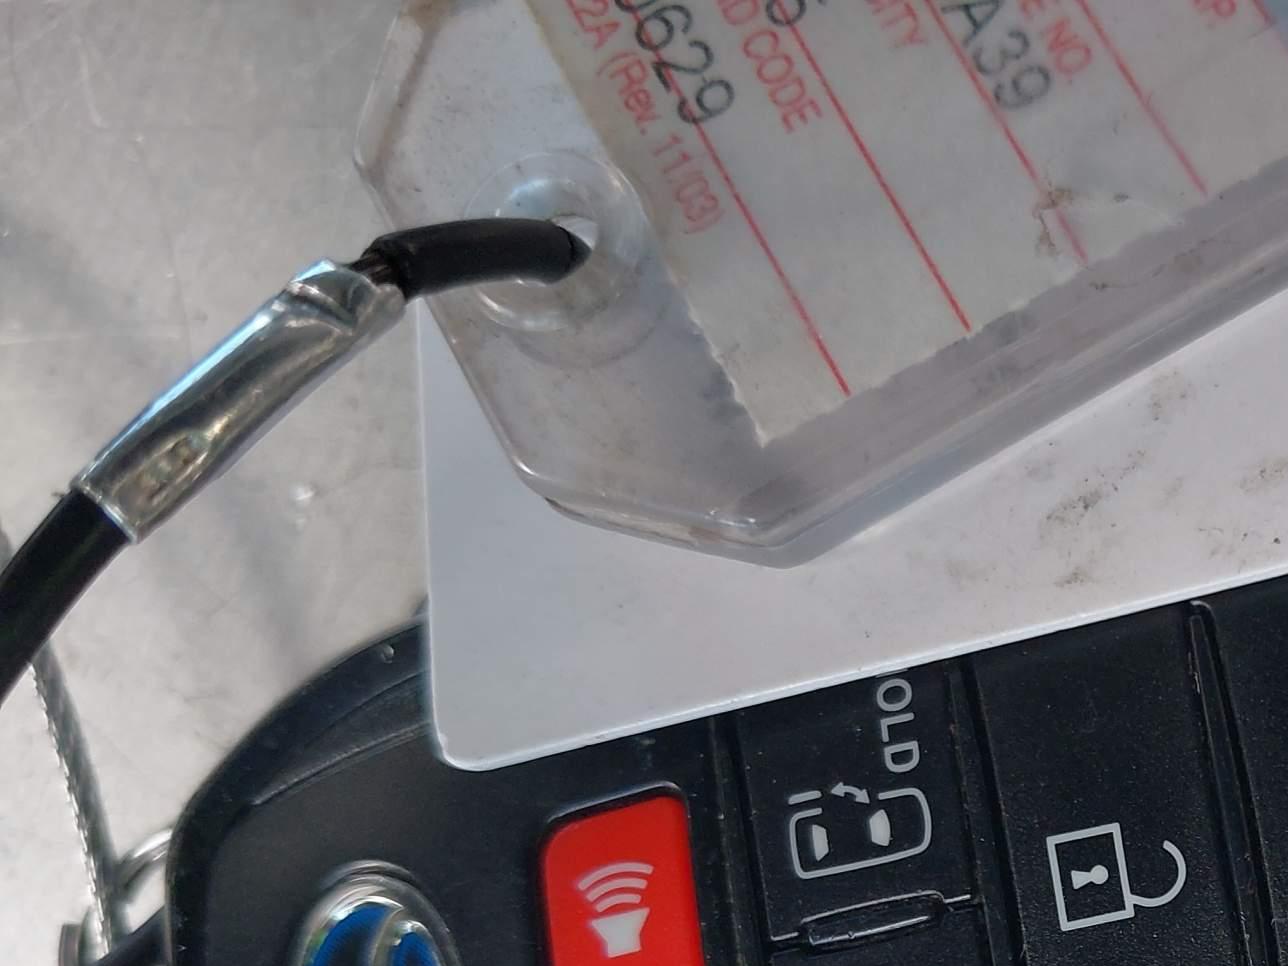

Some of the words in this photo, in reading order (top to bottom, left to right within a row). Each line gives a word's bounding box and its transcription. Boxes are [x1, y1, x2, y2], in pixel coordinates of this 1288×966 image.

[742, 28, 825, 135] CODE
[1045, 17, 1093, 86] NO.
[596, 50, 662, 136] (Rev.
[653, 131, 727, 235] 11/03)
[875, 668, 921, 773] OLD
